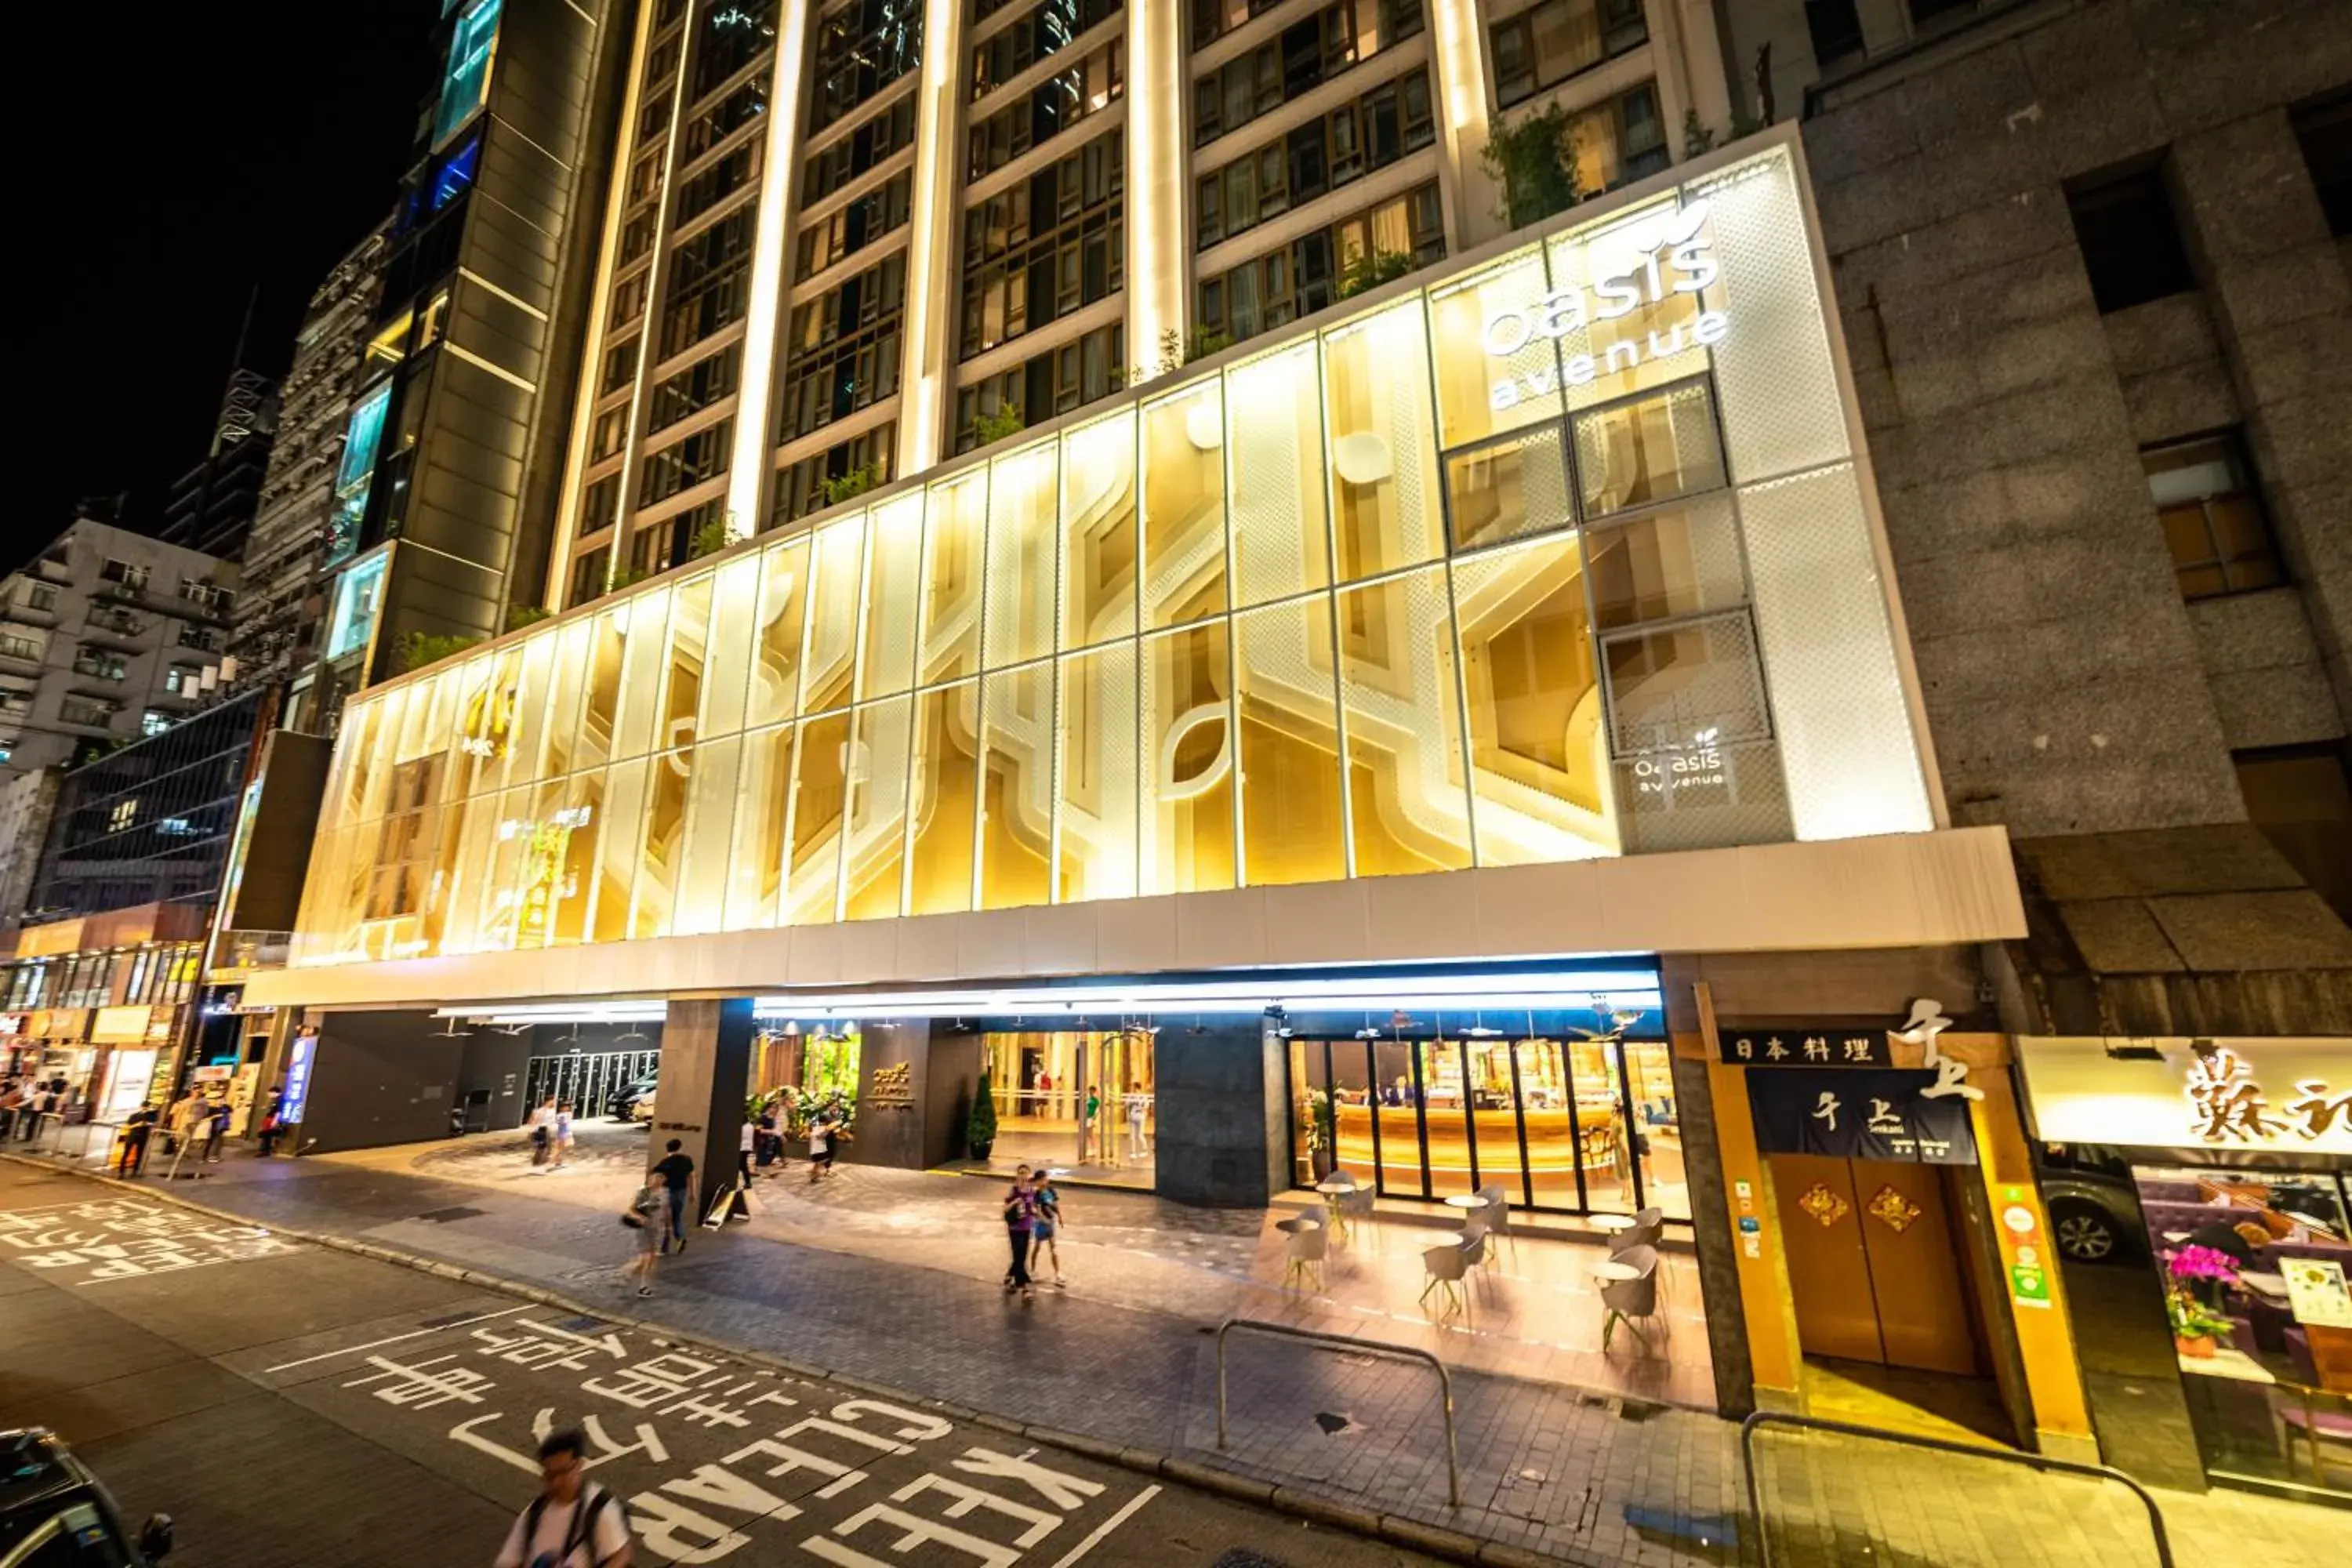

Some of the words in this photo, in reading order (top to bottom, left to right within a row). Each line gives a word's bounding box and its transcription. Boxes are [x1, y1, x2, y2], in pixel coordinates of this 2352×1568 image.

[1481, 234, 1720, 356] oasis
[1489, 310, 1731, 411] avenue
[1735, 1035, 1874, 1062] 日本料理
[17, 1226, 270, 1268] CLEAR
[342, 1317, 628, 1411] 停車
[448, 1354, 798, 1476] 請勿
[627, 1399, 954, 1565] CLEAR
